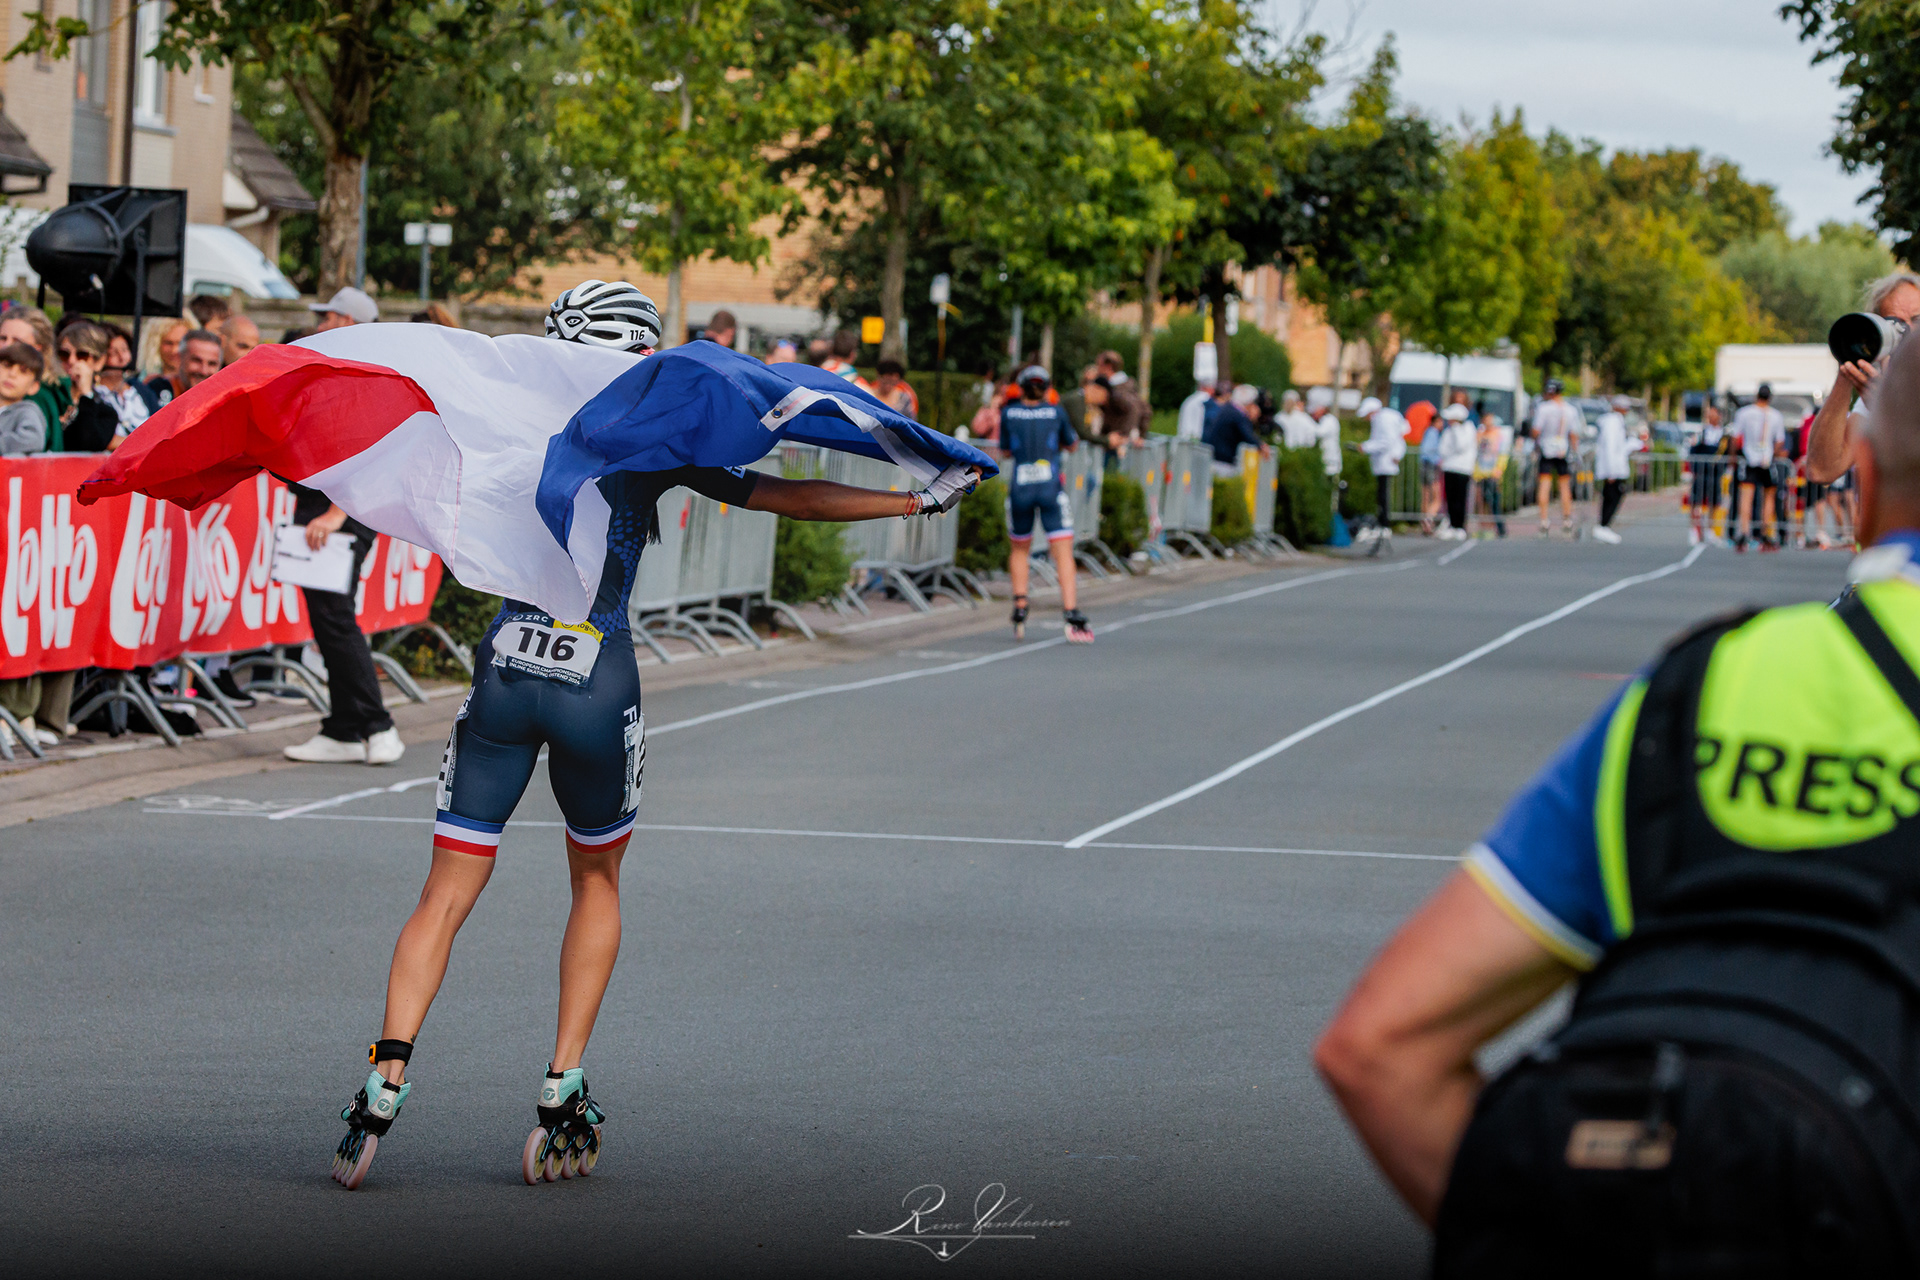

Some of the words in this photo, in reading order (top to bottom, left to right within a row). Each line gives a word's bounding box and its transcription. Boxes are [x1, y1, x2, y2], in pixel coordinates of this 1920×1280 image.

[629, 329, 645, 341] 116
[525, 614, 549, 623] ZRC
[517, 626, 579, 662] 116
[509, 662, 526, 671] INLINE
[526, 667, 549, 678] SKATING
[511, 658, 541, 671] EUROPEAN
